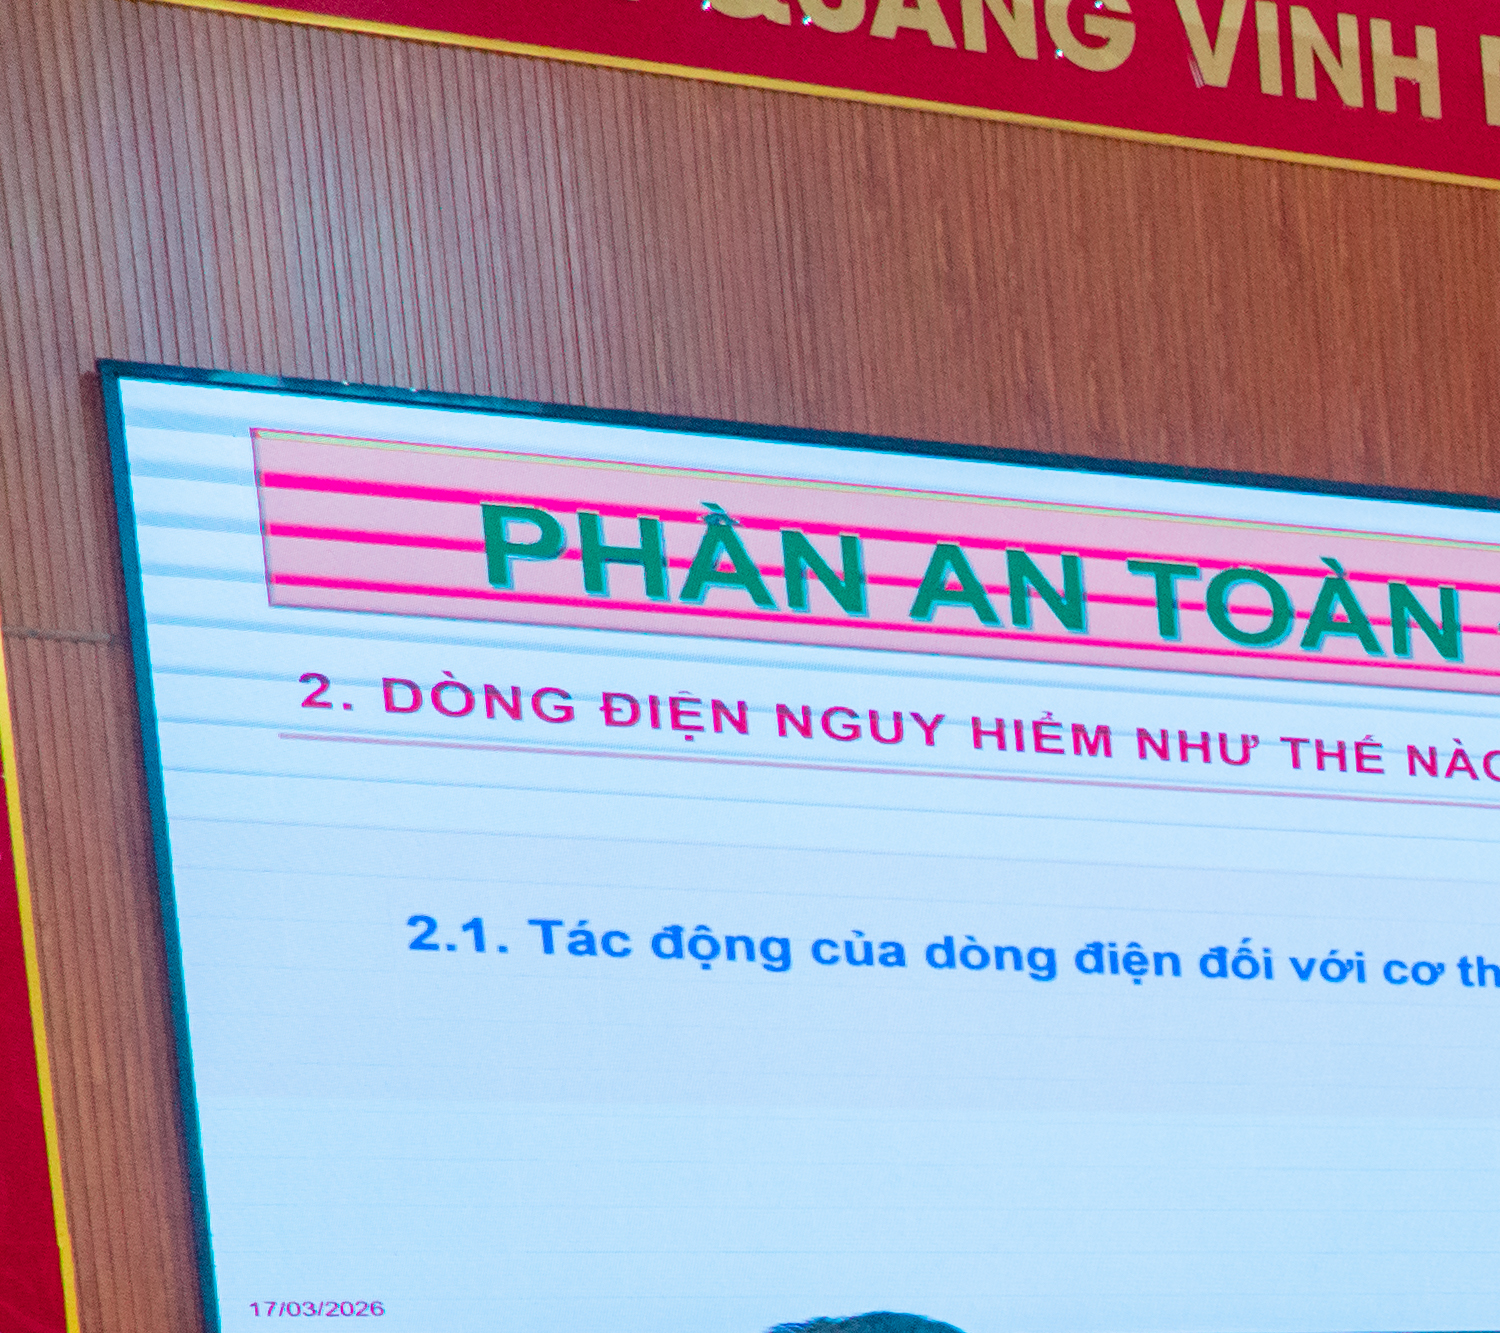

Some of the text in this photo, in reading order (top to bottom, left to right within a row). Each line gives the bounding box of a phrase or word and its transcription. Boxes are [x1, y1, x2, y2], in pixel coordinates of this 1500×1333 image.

[1183, 0, 1443, 119] VINH
[481, 502, 869, 617] PHẦN
[909, 544, 1088, 634] AN
[1127, 557, 1464, 663] TOÀN
[299, 673, 351, 710] 2.
[382, 671, 574, 723] DÒNG
[599, 692, 748, 741] ĐIỆN
[776, 704, 945, 746] NGUY
[972, 712, 1111, 757] HIỂM
[1137, 728, 1259, 765] NHƯ
[1280, 735, 1384, 774] THẾ
[407, 915, 508, 953] 2.1.
[528, 919, 633, 958] Tác
[651, 925, 792, 972] động
[811, 930, 907, 968] của
[926, 935, 1057, 982] dòng
[1075, 941, 1181, 985] điện
[1199, 937, 1273, 980] đối
[1289, 950, 1366, 983] với
[1383, 960, 1445, 986] cơ
[250, 1302, 384, 1316] 17/03/2026
